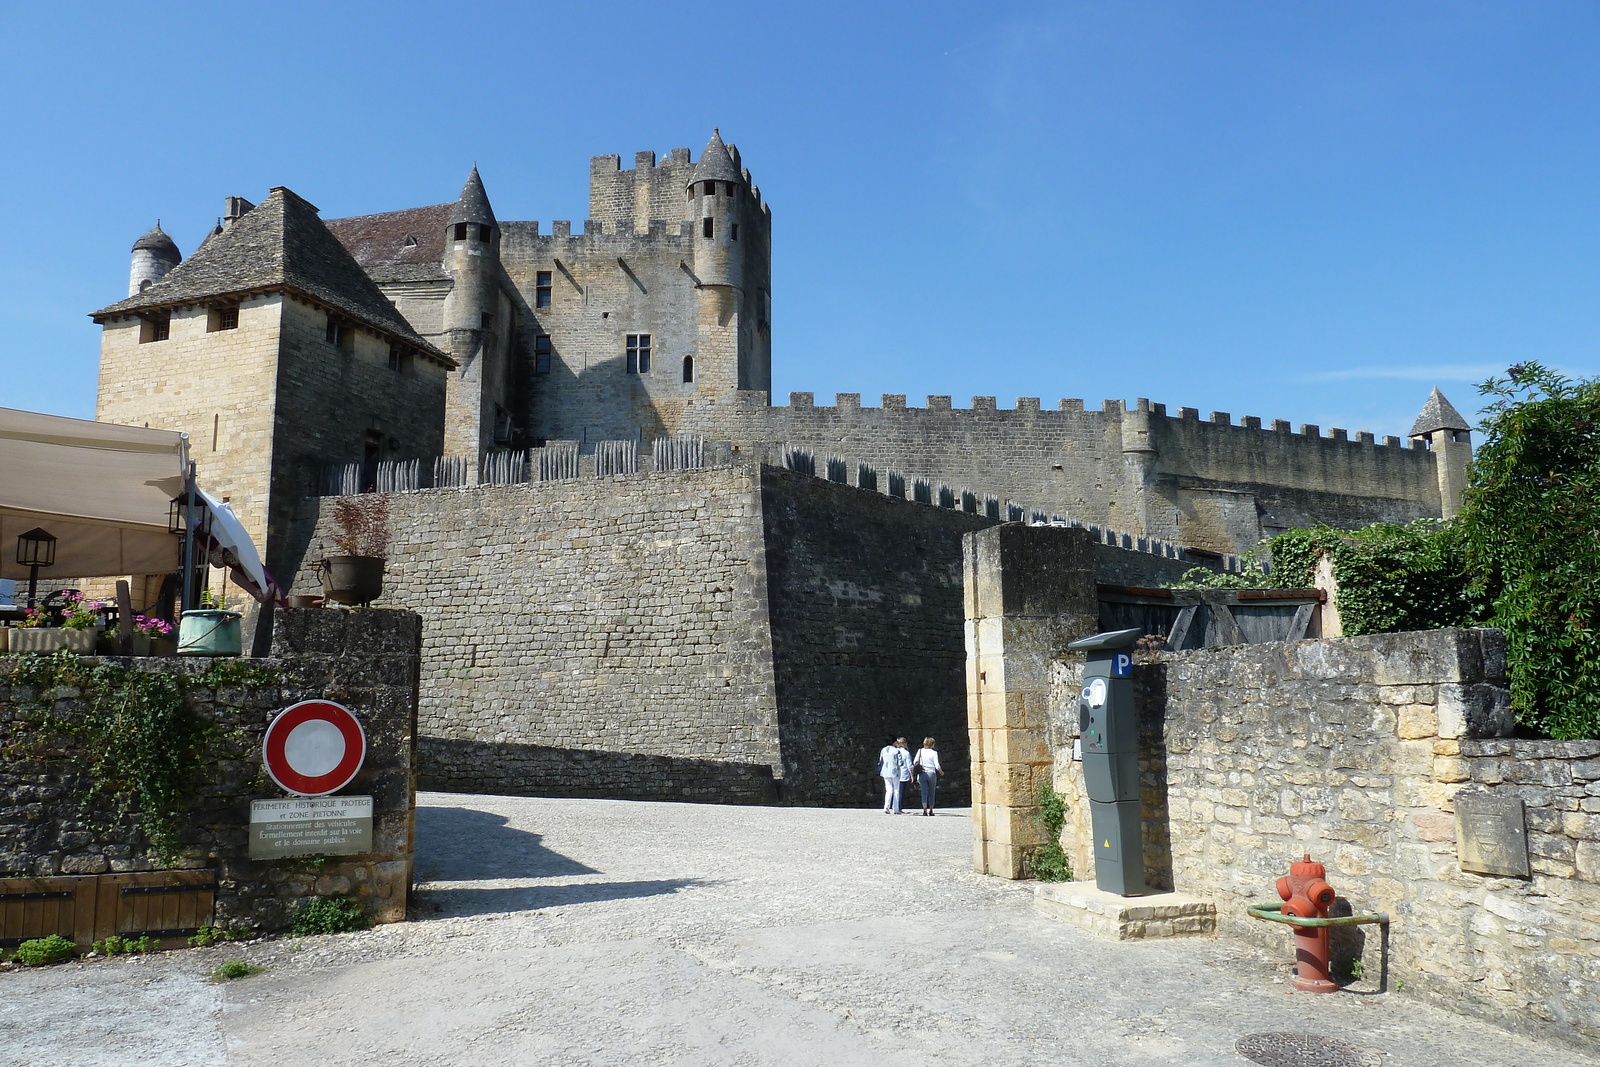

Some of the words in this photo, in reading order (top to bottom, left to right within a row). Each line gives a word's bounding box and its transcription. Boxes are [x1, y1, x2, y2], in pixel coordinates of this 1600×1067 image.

[1118, 654, 1129, 674] P
[253, 802, 291, 810] PERIMETRE
[295, 800, 336, 808] HISTORIQUE
[313, 810, 346, 818] PIETONNE
[266, 822, 312, 830] Stationnement
[260, 830, 303, 839] formellement
